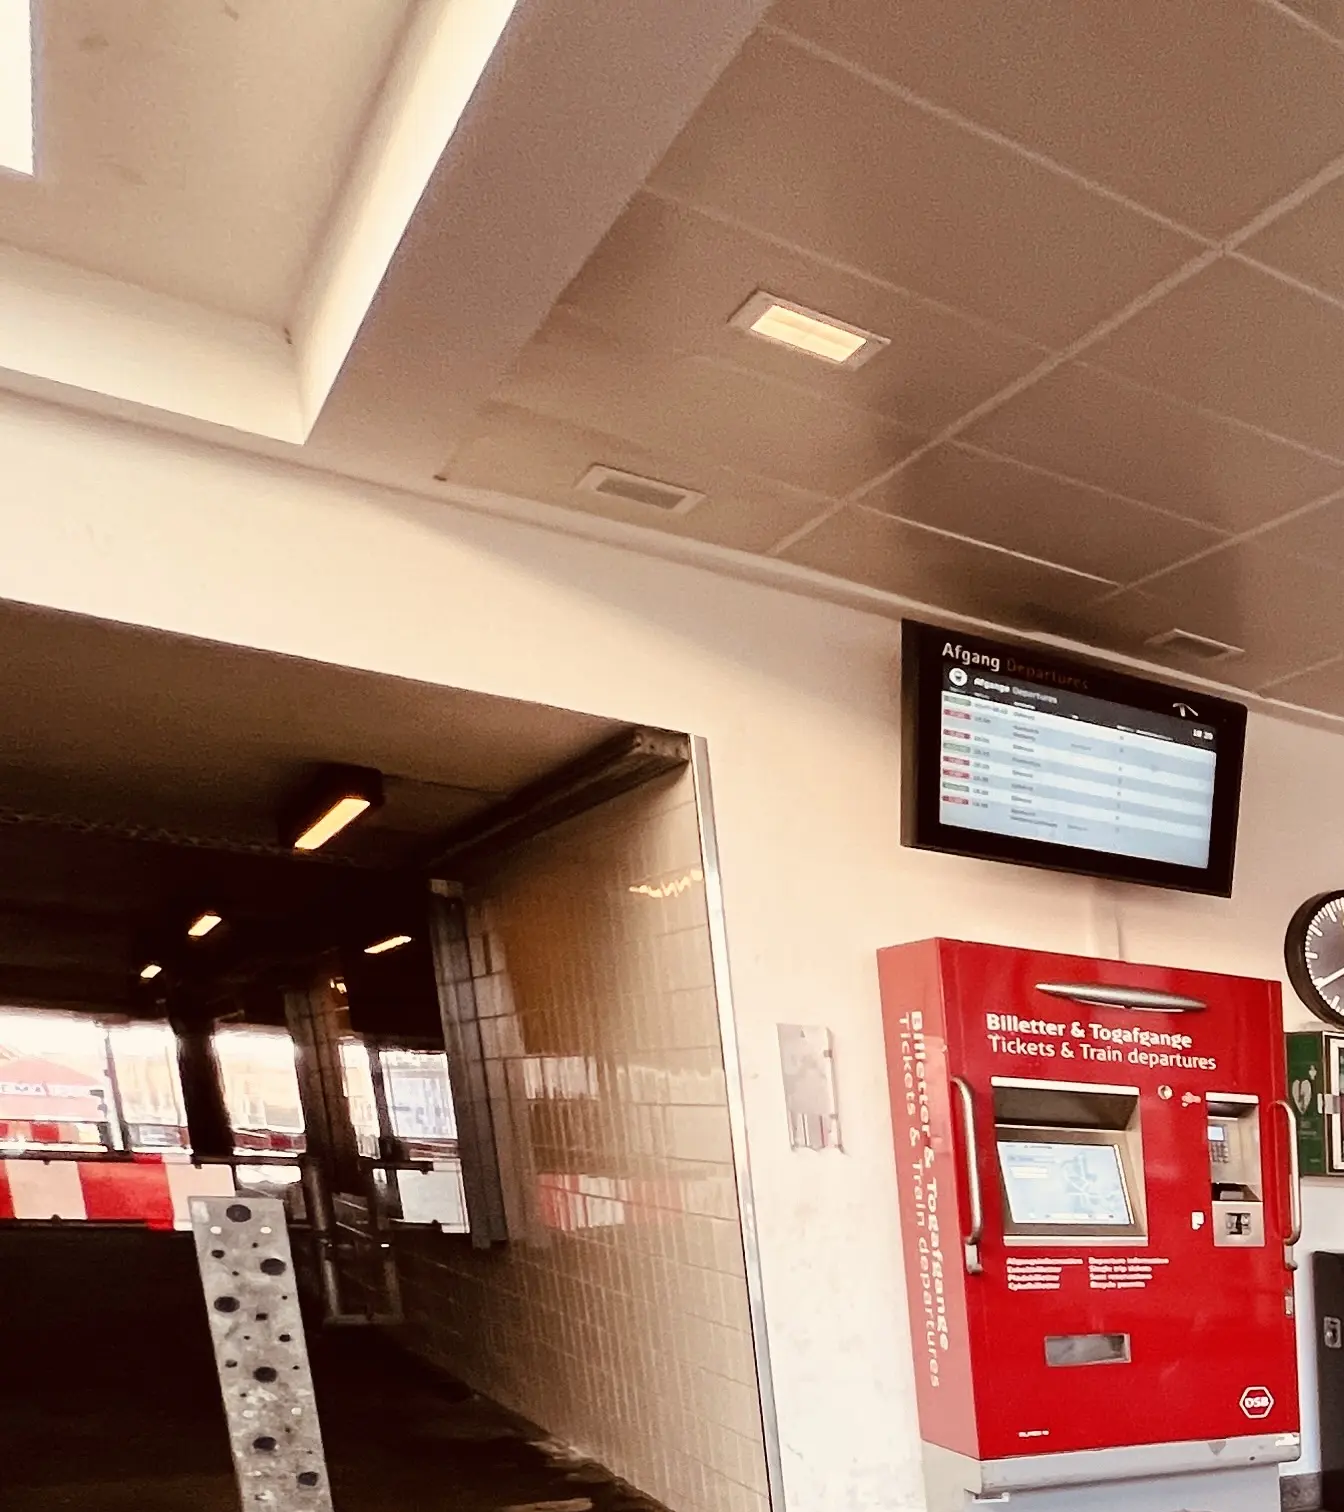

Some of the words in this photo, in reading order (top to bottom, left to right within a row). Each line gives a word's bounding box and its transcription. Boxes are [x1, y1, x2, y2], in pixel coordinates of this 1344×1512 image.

[942, 642, 1000, 672] Afgang
[986, 1013, 1066, 1037] Billetter
[1071, 1021, 1085, 1038] &
[1089, 1023, 1192, 1050] Togafgange
[899, 1012, 916, 1116] Tickets
[987, 1033, 1055, 1057] Tickets
[1060, 1042, 1075, 1059] &
[1080, 1043, 1122, 1063] Train
[1127, 1047, 1217, 1070] departures
[911, 1011, 931, 1138] Billetter
[909, 1127, 920, 1146] &
[924, 1146, 935, 1168] &
[912, 1158, 927, 1226] Train
[927, 1177, 948, 1350] Togafgange
[918, 1237, 939, 1387] departures
[1244, 1396, 1269, 1408] DSB
